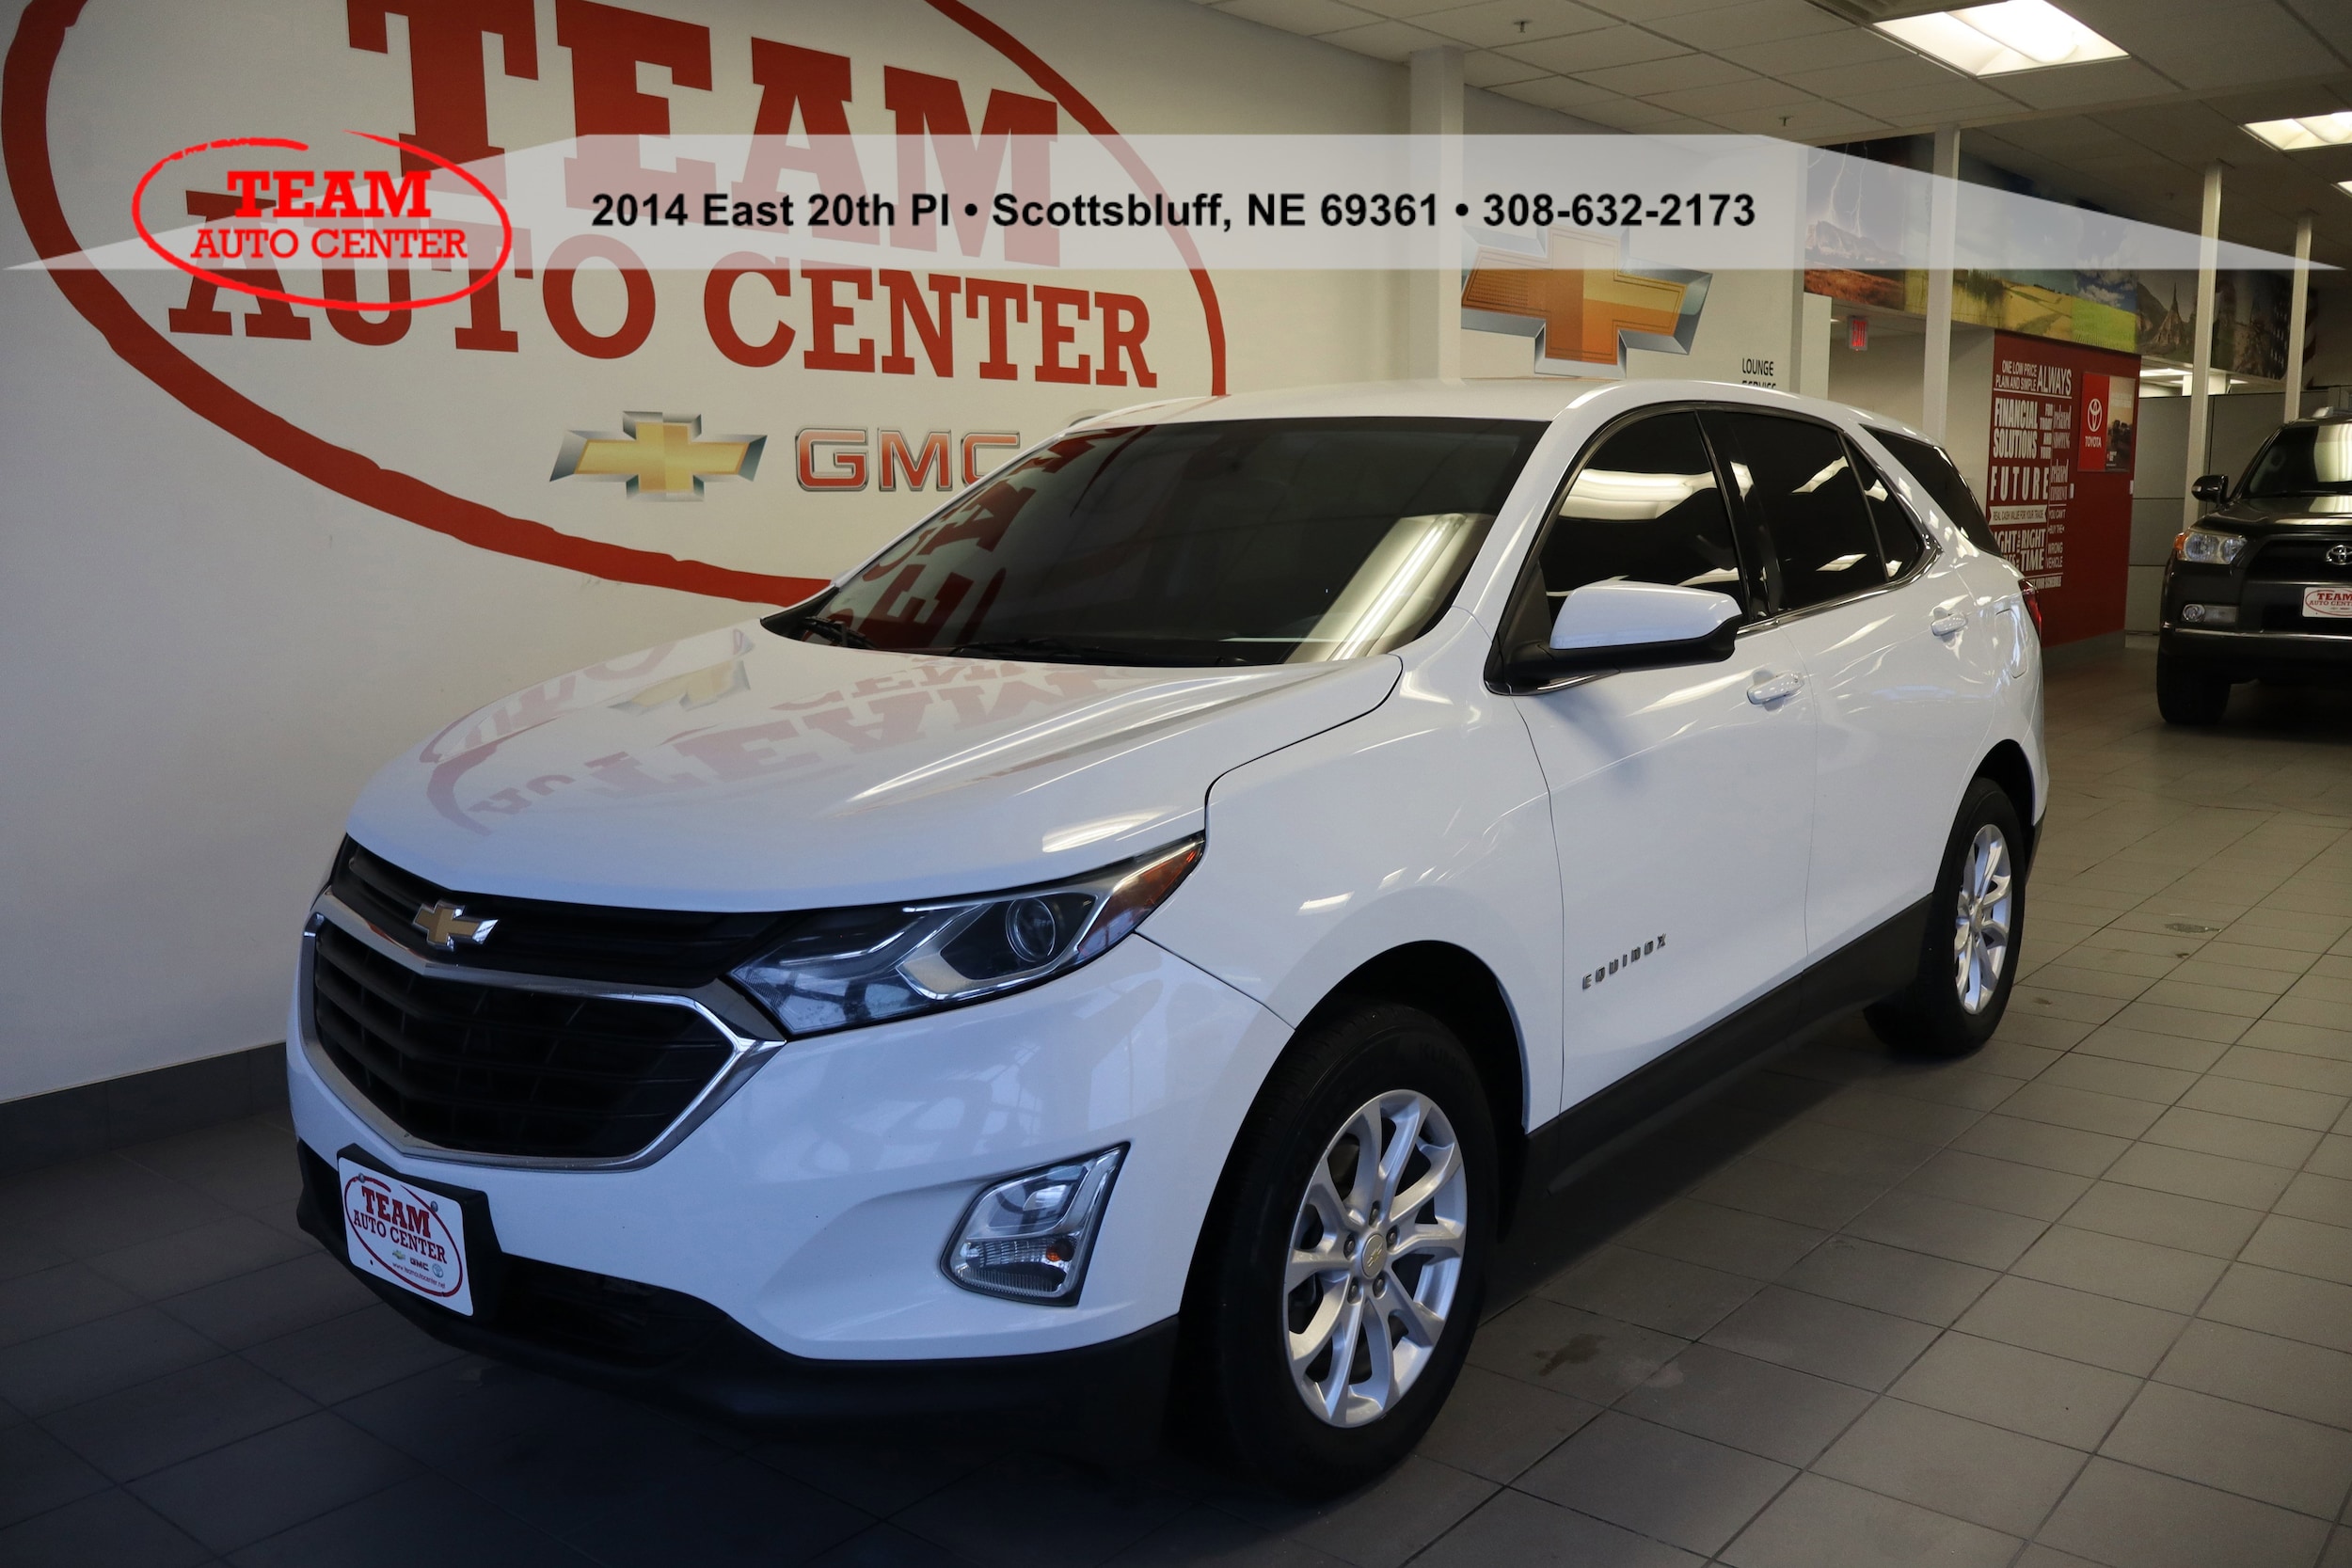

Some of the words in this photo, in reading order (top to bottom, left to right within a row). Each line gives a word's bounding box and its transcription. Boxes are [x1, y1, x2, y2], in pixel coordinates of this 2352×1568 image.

[346, 0, 1060, 267] TEAM
[167, 190, 657, 359] AUTO
[704, 251, 1158, 388] CENTER
[1741, 357, 1774, 377] LOUNGE
[1994, 374, 2010, 389] PLAIN
[2010, 375, 2020, 390] AND
[2020, 377, 2037, 392] SIMPLE
[2001, 359, 2012, 374] ONE
[2012, 361, 2025, 376] LOW
[2024, 362, 2037, 378] PRICE
[2037, 364, 2073, 396] ALWAYS
[1994, 397, 2038, 430] FINANCIAL
[795, 425, 1022, 492] GMC
[1993, 427, 2038, 460] SOLUTIONS
[2084, 436, 2102, 449] TOYOTA
[1990, 466, 2050, 501] FUTURE
[2021, 529, 2046, 549] RIGHT
[2047, 542, 2063, 555] WRONG
[2020, 547, 2045, 572] TIME
[2317, 593, 2352, 601] TEAM
[1582, 933, 1666, 990] EQUINOX
[361, 1185, 432, 1239] TEAM
[353, 1209, 387, 1239] AUTO
[389, 1227, 448, 1265] CENTER
[409, 1257, 430, 1272] GMC
